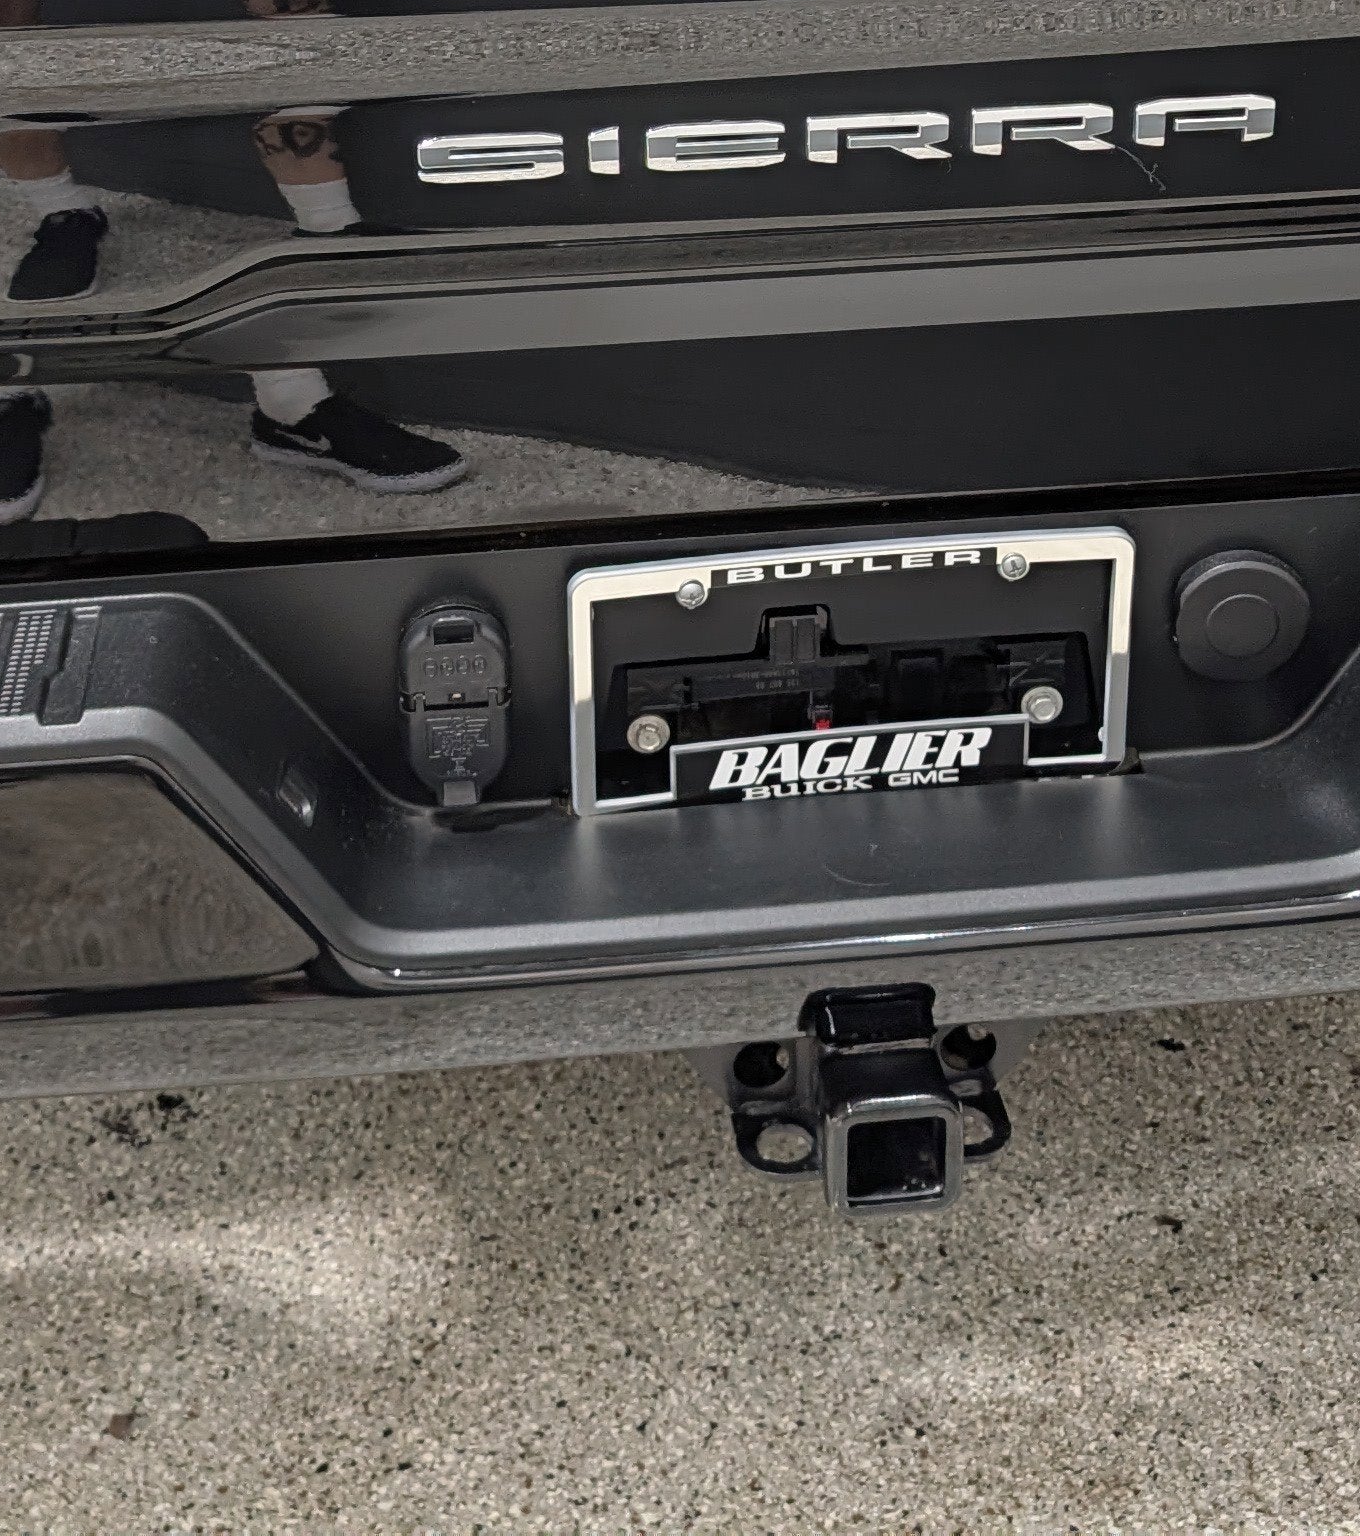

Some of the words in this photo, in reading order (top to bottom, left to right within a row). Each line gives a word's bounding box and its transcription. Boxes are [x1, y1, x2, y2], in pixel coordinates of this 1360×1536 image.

[416, 92, 1277, 184] SIERRA
[726, 549, 981, 585] BUTLER
[708, 726, 993, 791] BAGLIER
[742, 775, 873, 801] BUICK
[888, 767, 960, 787] GMC
